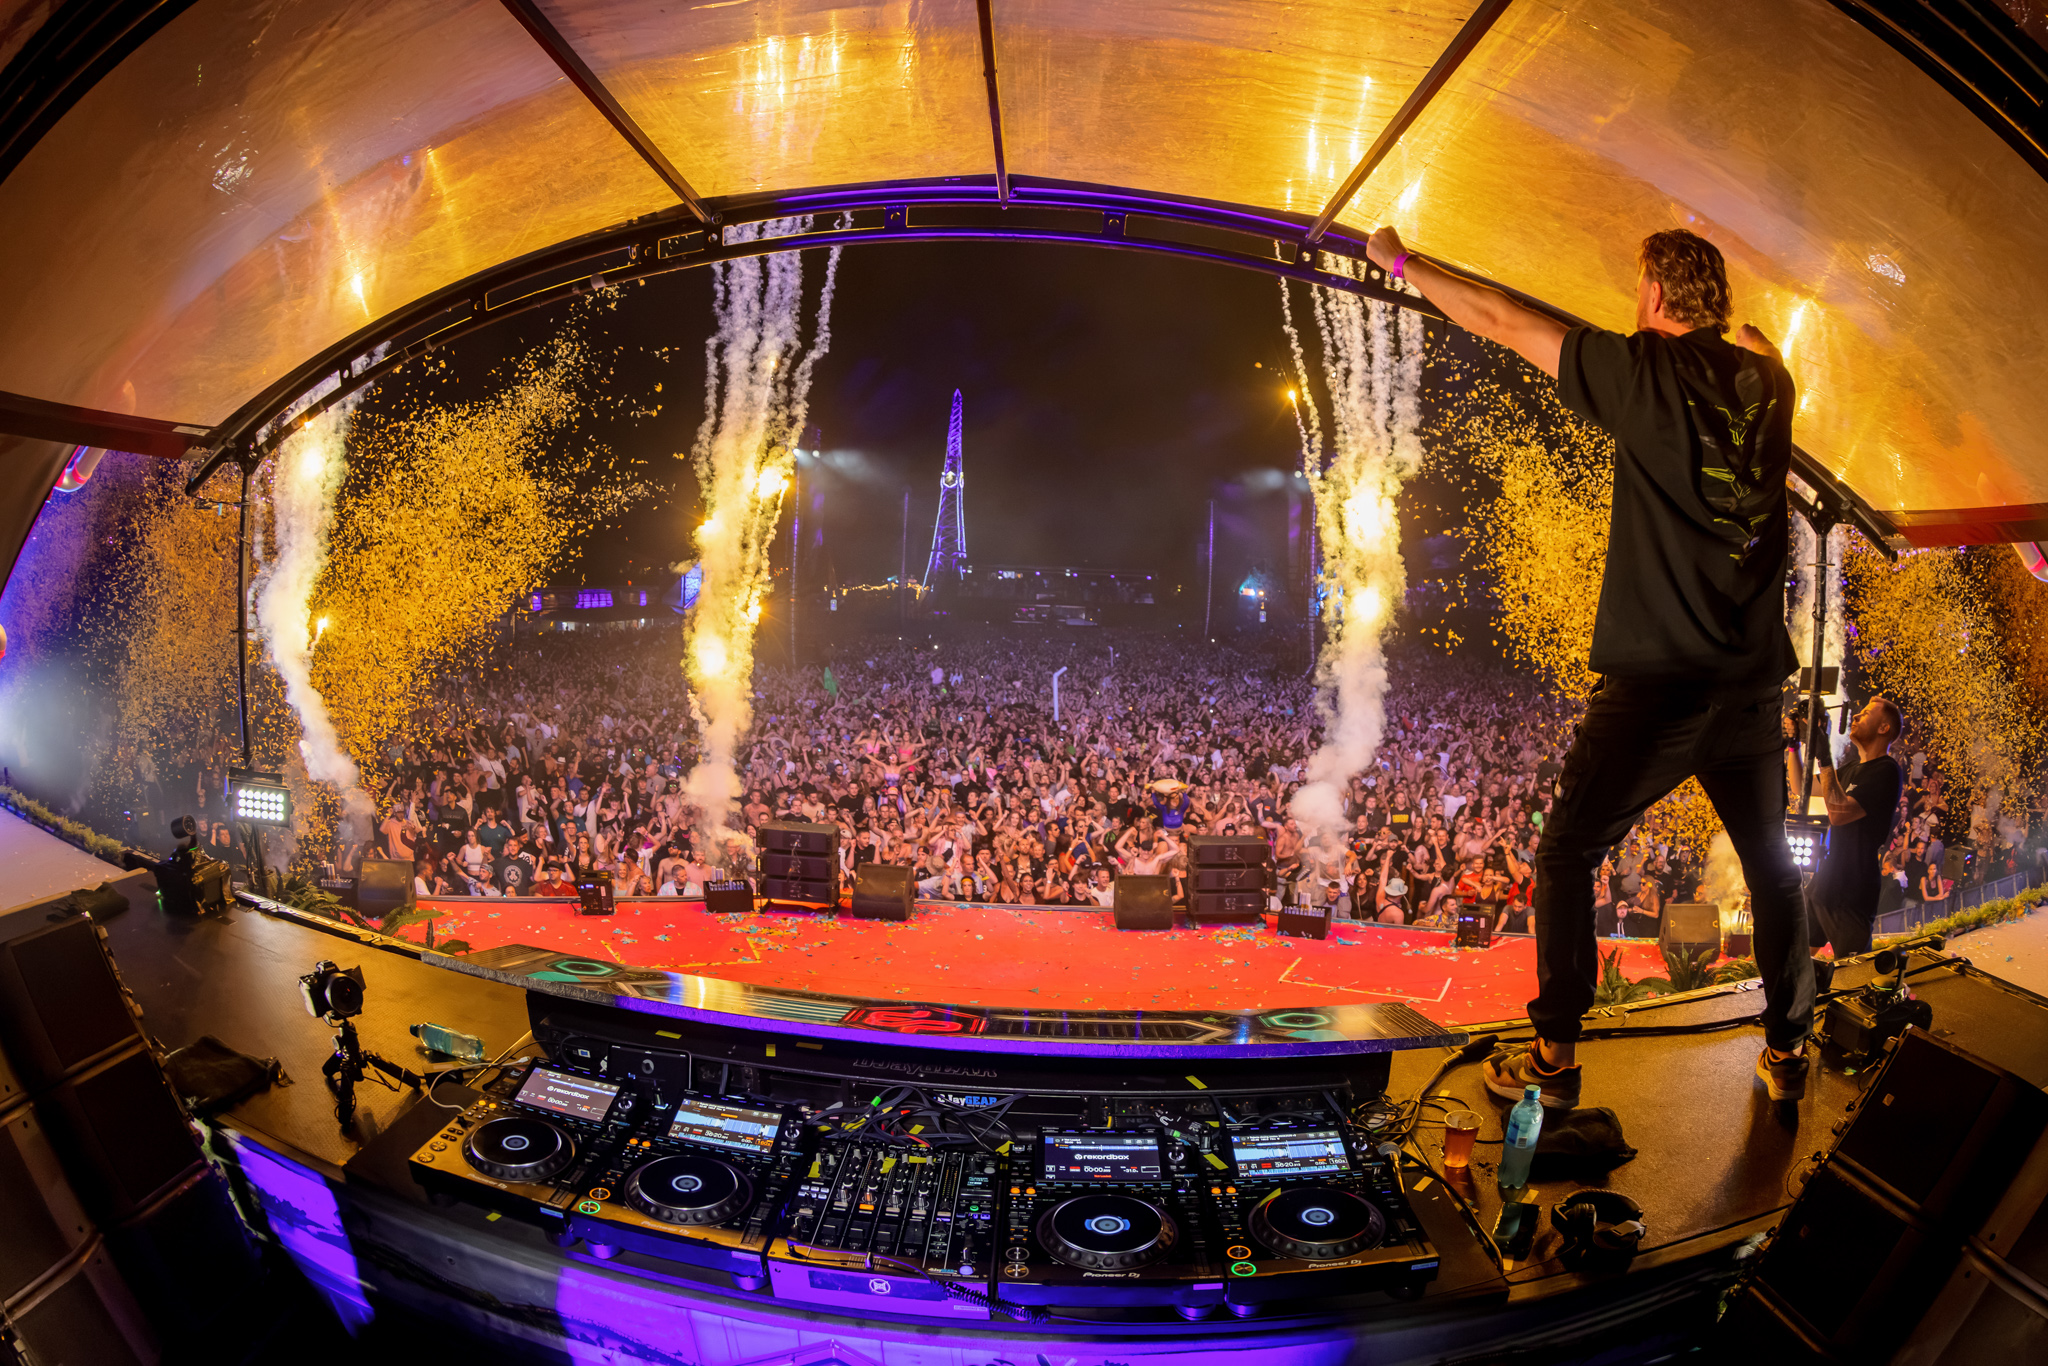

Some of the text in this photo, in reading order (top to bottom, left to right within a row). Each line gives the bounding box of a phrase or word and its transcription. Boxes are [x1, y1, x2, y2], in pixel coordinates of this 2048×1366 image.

[553, 1087, 590, 1100] rekordbox
[641, 1220, 678, 1232] Pioneer
[1308, 1261, 1349, 1269] Pioneer
